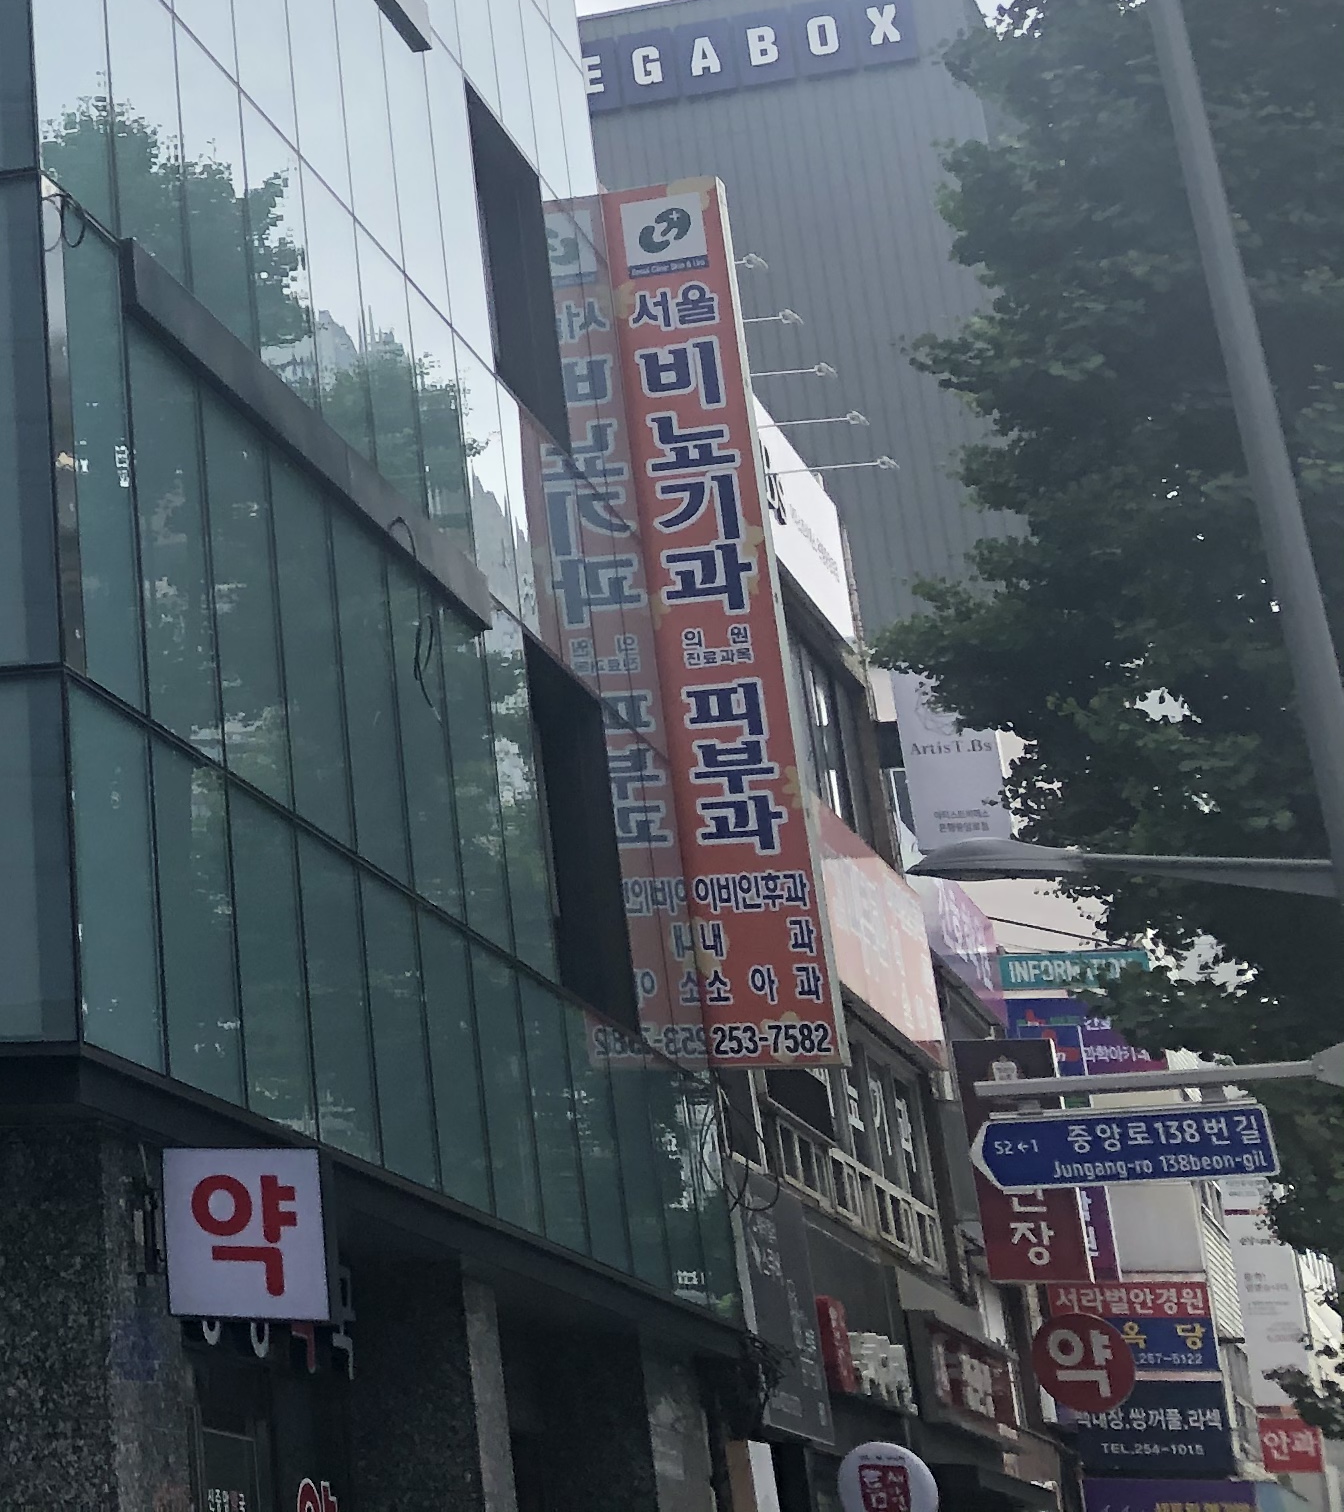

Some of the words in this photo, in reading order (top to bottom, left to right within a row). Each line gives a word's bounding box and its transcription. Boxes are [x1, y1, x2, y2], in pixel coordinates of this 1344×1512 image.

[632, 284, 717, 329] 서울
[639, 337, 752, 613] 비뇨기과
[685, 647, 752, 667] 진료과목
[683, 679, 784, 854] 피부과
[694, 872, 810, 913] 이비인후과
[712, 1022, 833, 1056] 253-7582
[1067, 1115, 1261, 1154] 중앙로138번길
[1054, 1160, 1153, 1179] Jungang-ro
[1159, 1150, 1268, 1173] 138beon-gil
[191, 1174, 298, 1298] 약
[1055, 1287, 1206, 1317] 서라벌안경원
[1046, 1328, 1114, 1398] 약
[1263, 1429, 1321, 1461] 안과
